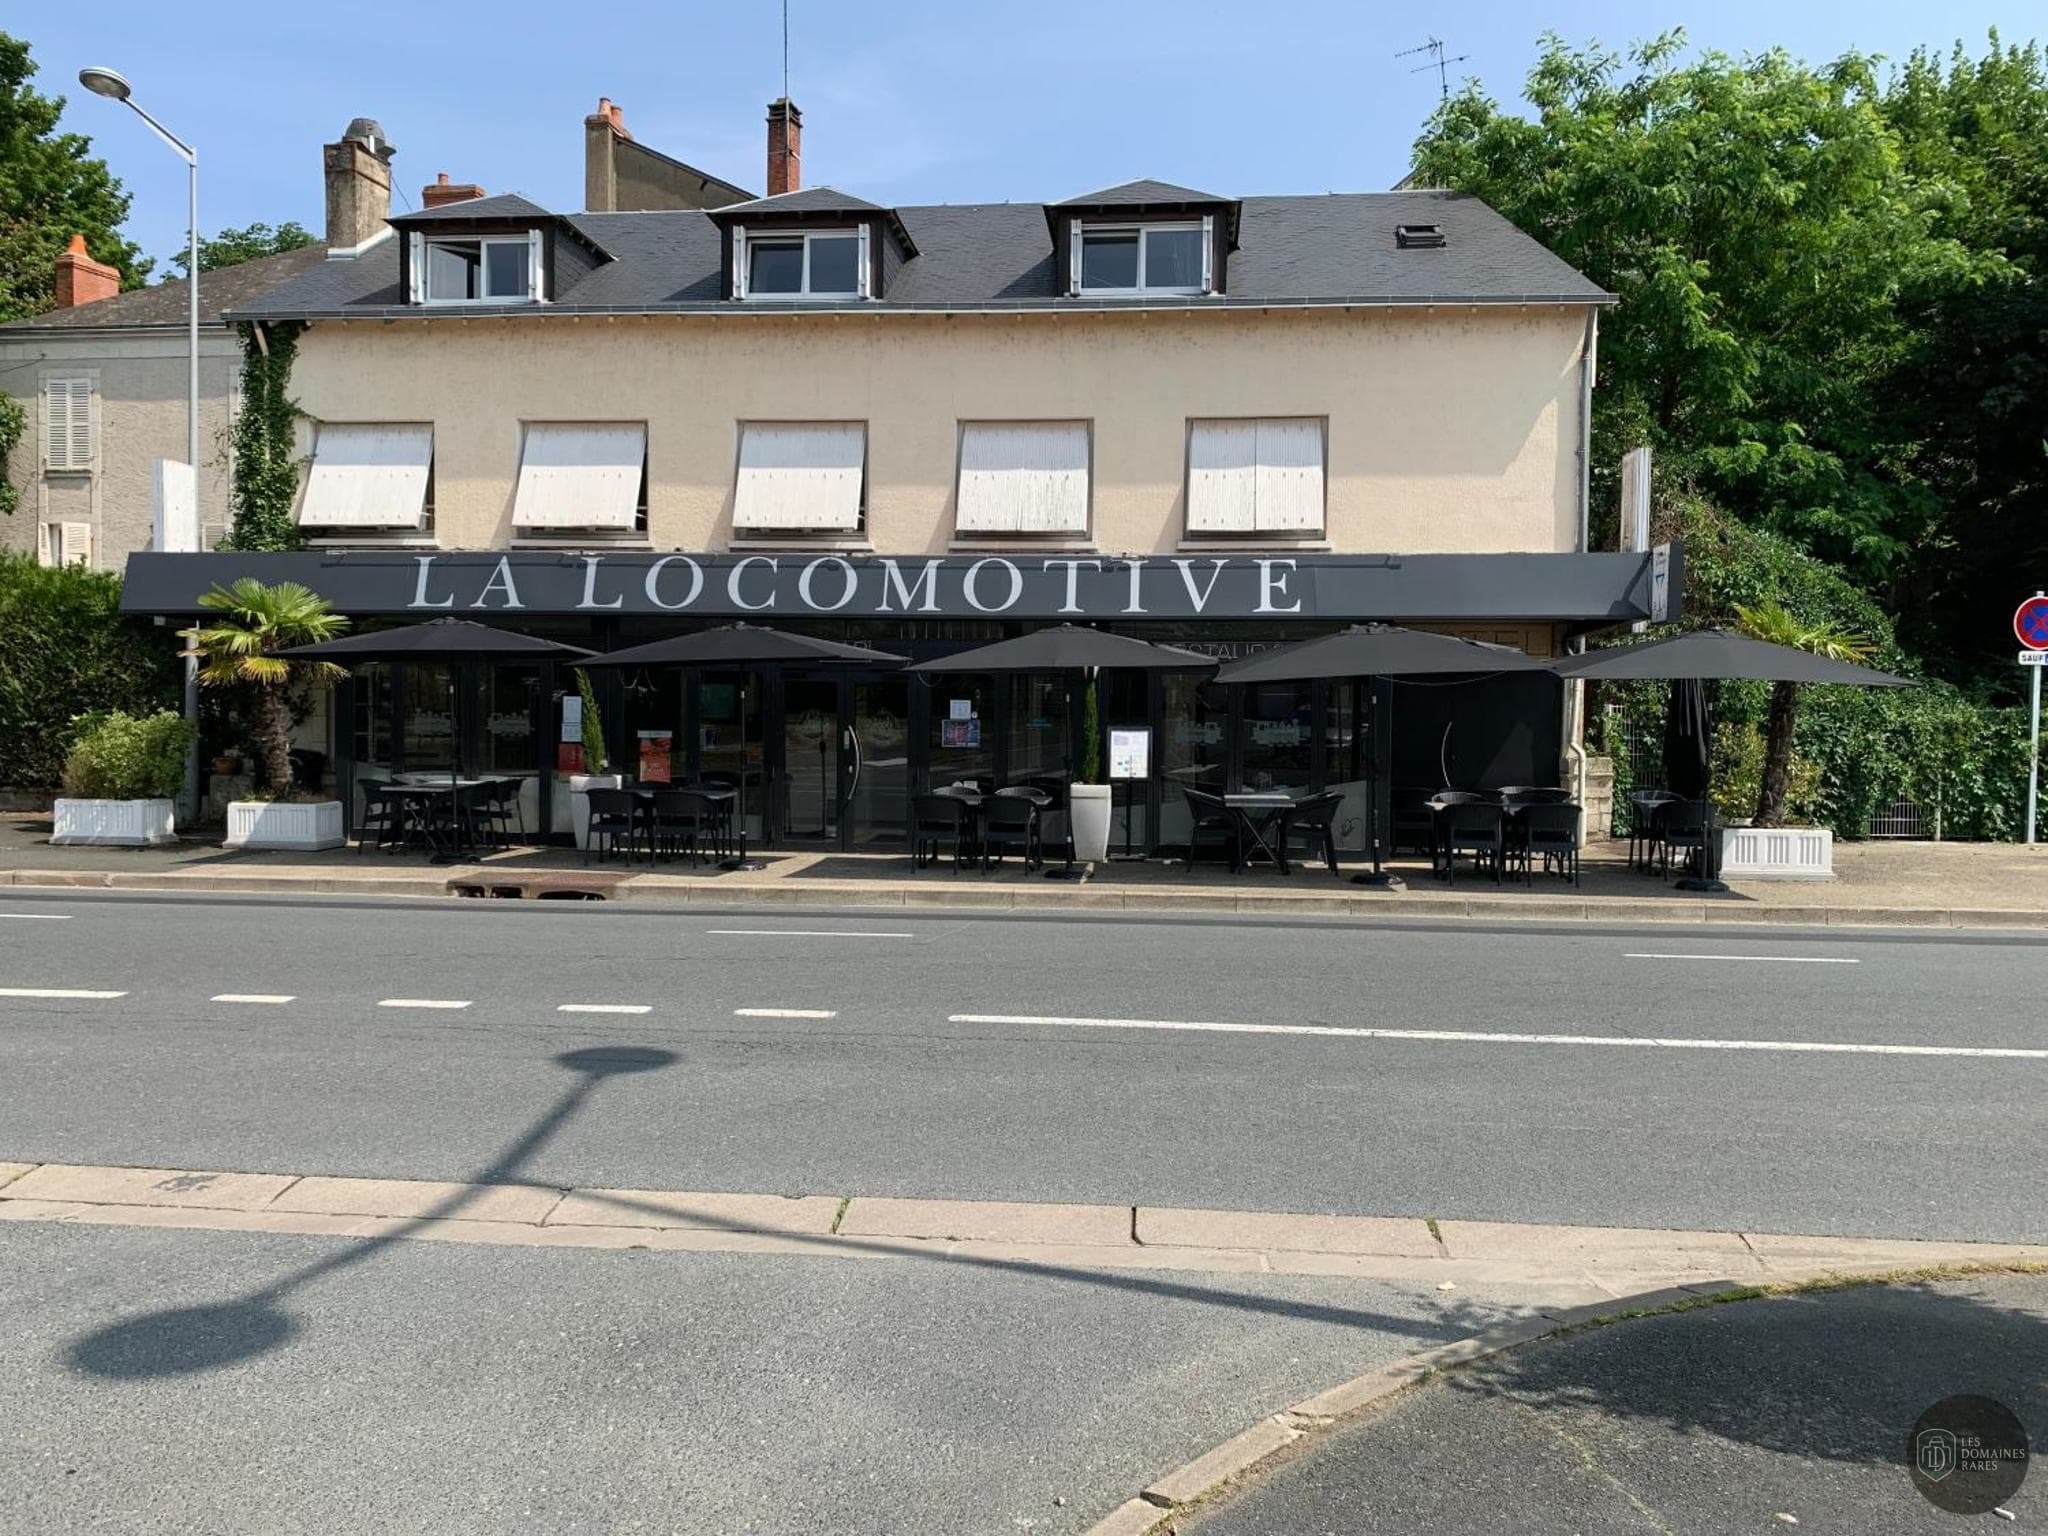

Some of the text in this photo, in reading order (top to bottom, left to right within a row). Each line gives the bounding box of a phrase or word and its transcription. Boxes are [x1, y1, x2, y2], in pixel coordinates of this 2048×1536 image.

[407, 555, 1302, 614] LA LOCOMOTIVE
[2021, 653, 2043, 662] SAUF
